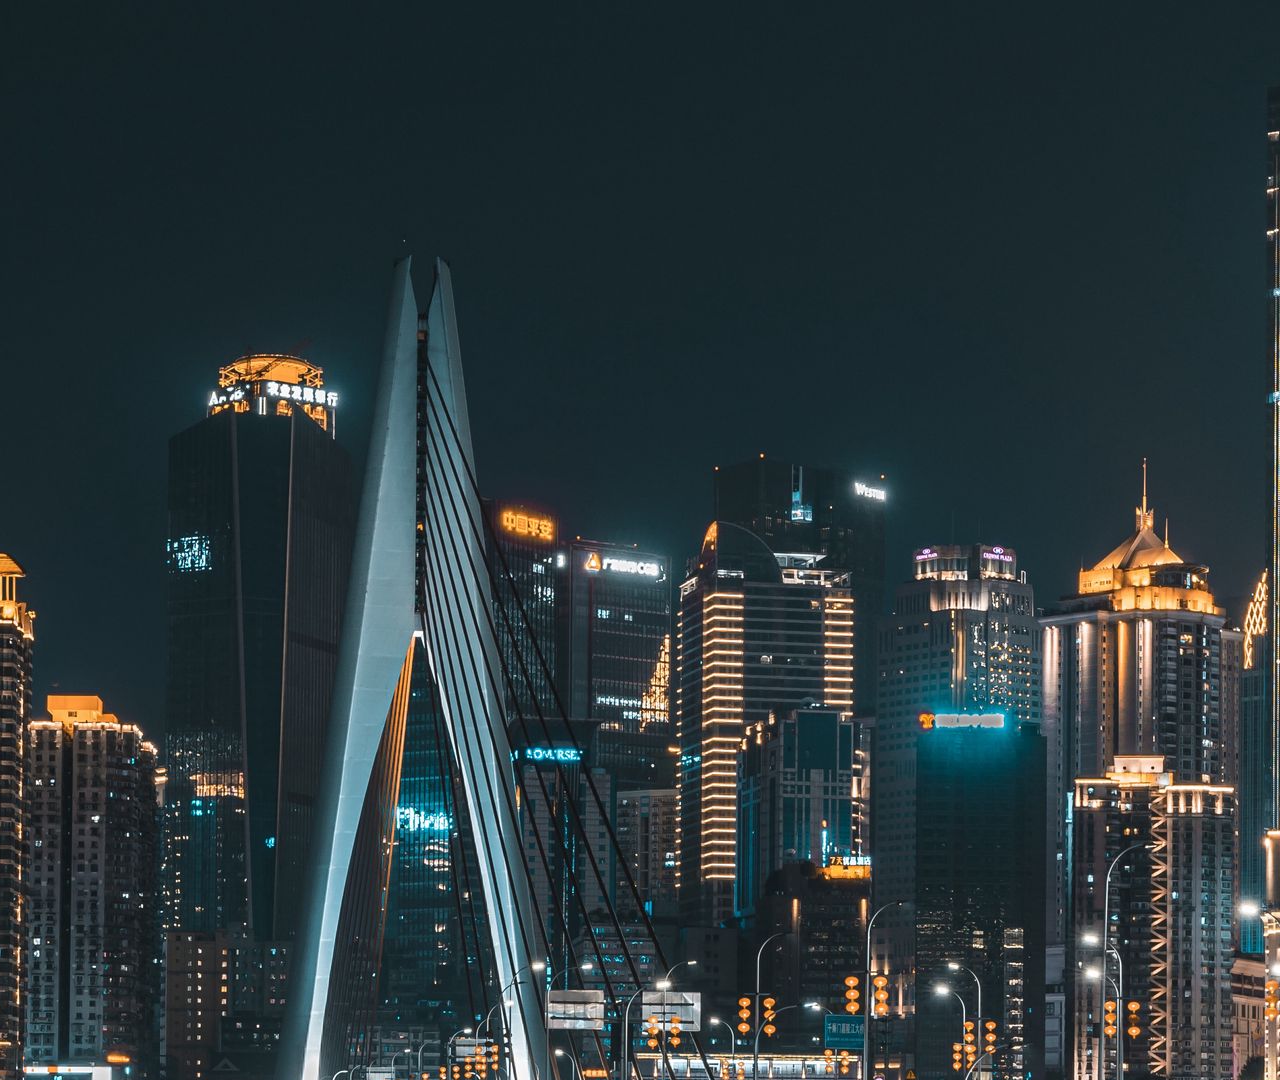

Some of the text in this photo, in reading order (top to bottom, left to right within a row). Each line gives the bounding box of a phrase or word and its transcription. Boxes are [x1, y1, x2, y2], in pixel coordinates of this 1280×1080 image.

[502, 511, 553, 540] 中国平安
[999, 554, 1013, 562] PLAZA
